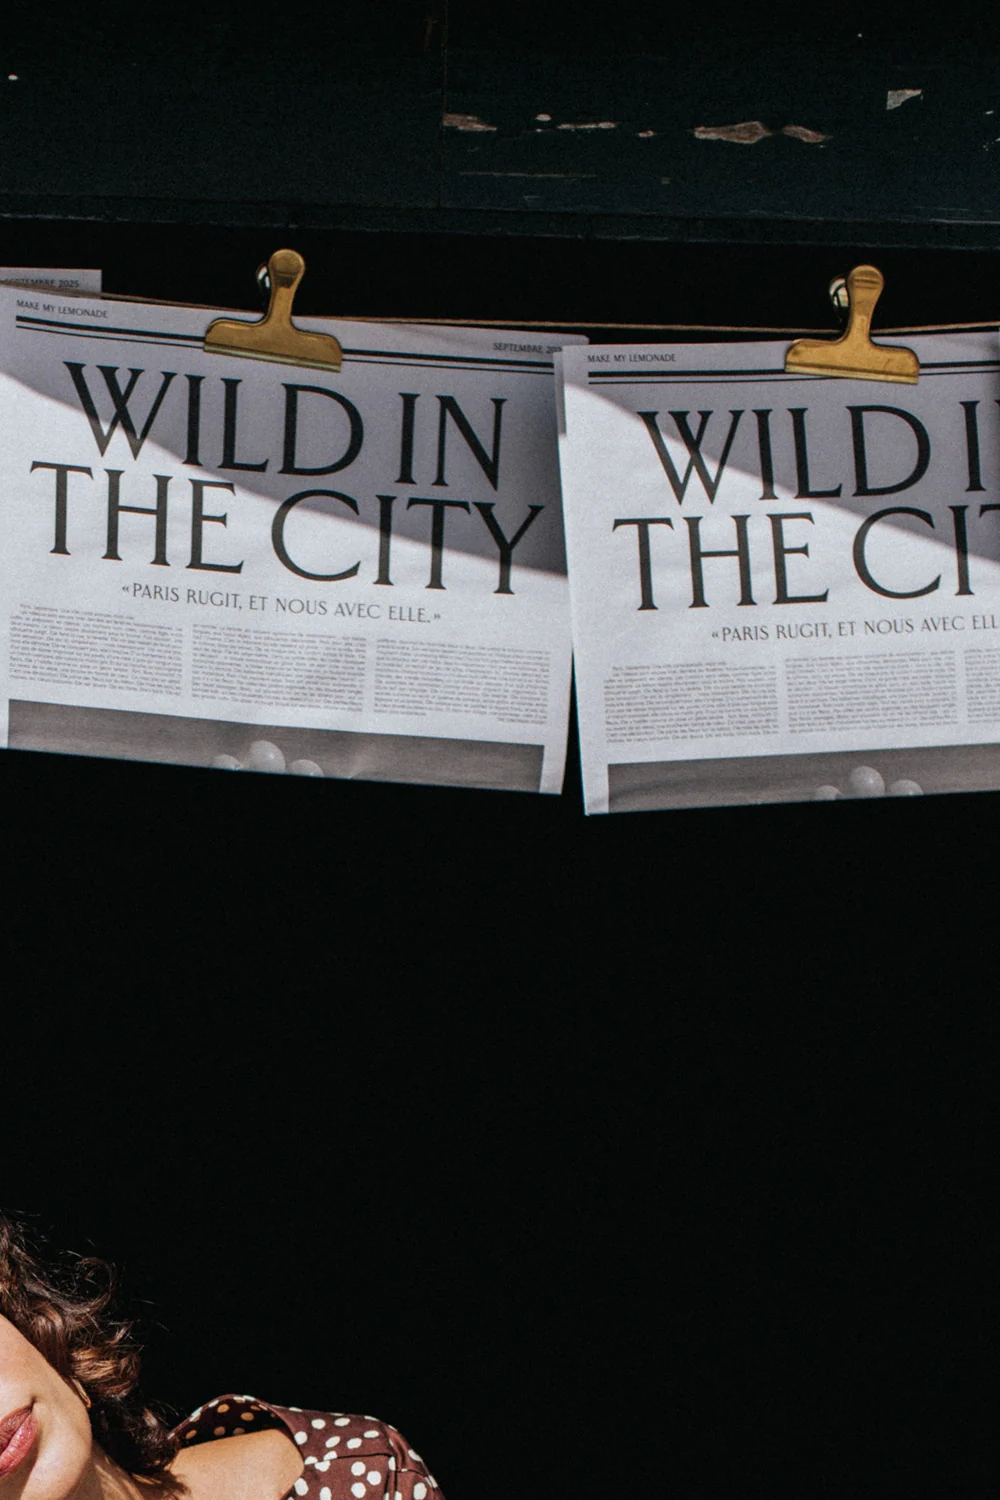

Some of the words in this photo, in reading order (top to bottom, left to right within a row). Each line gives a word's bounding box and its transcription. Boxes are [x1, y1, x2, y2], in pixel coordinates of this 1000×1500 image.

[58, 279, 80, 289] 2025
[16, 299, 40, 310] MAKE
[42, 303, 56, 313] MY
[58, 306, 109, 319] LEMONADE
[493, 342, 543, 354] SEPTEMBRE
[587, 354, 610, 363] MAKE
[613, 353, 627, 362] MY
[628, 352, 676, 362] LEMONADE
[62, 360, 364, 477] WILD
[394, 391, 508, 492] IN
[637, 404, 932, 506] WILD
[959, 400, 1000, 492] I
[30, 460, 245, 575] THE
[271, 488, 545, 595] CITY
[612, 510, 830, 611] THE
[852, 503, 1000, 600] CI
[122, 582, 180, 602] «PARIS
[186, 588, 243, 611] RUGIT,
[249, 594, 269, 611] ET
[276, 597, 328, 616] NOUS
[334, 602, 382, 620] AVEC
[388, 605, 441, 624] ELLE.»
[711, 625, 769, 643] «PARIS
[776, 621, 833, 640] RUGIT,
[838, 620, 857, 637] ET
[864, 618, 915, 635] NOUS
[921, 615, 965, 632] AVEC
[972, 613, 1000, 630] ELL
